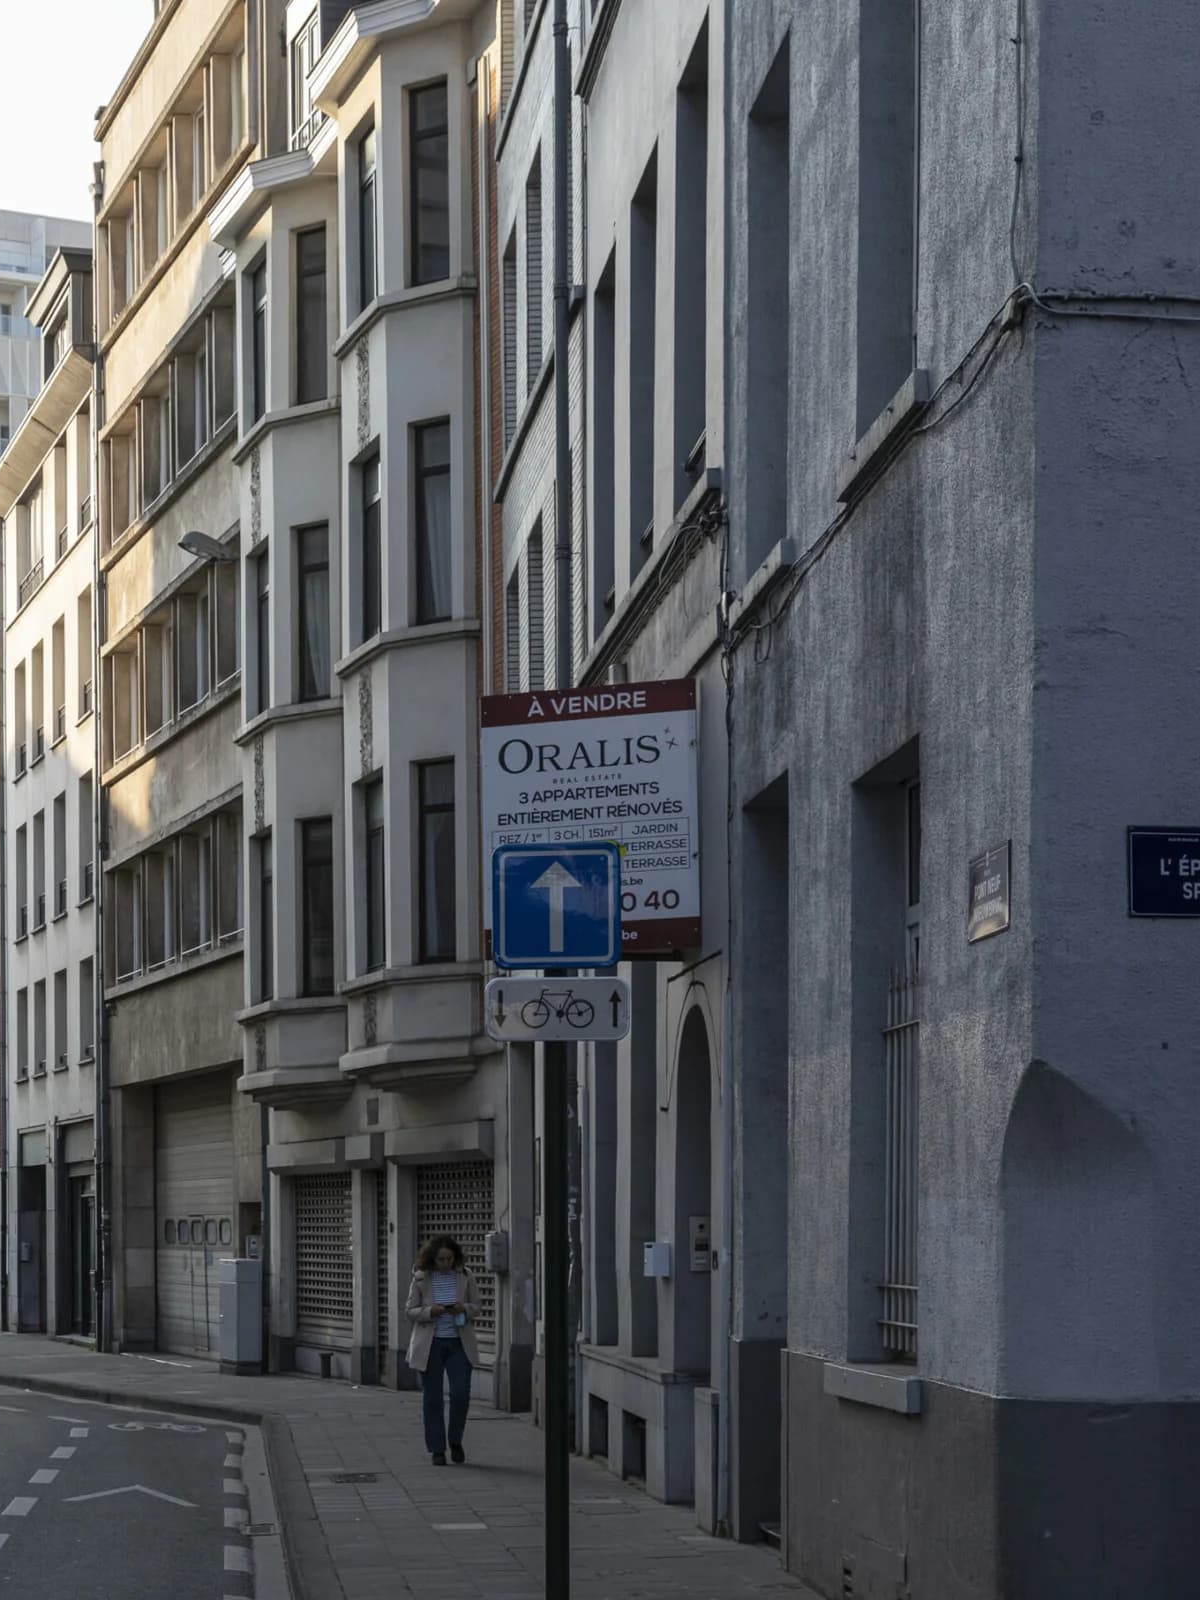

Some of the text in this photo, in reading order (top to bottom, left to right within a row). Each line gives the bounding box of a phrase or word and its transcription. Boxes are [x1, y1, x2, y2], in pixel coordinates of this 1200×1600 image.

[527, 690, 647, 718] À VENDRE
[498, 735, 660, 774] ORALIS
[553, 773, 622, 784] REAL ESTATE
[519, 781, 660, 804] 3 APPARTEMENTS
[497, 799, 683, 826] ENTIÈREMENT RÉNOVÉS
[554, 829, 582, 840] 3 CH.
[631, 823, 678, 835] JARDIN
[499, 833, 521, 844] REZ
[625, 839, 687, 851] TERRASSE
[624, 856, 687, 868] TERRASSE
[1178, 854, 1200, 876] ÉP
[644, 889, 680, 910] 40
